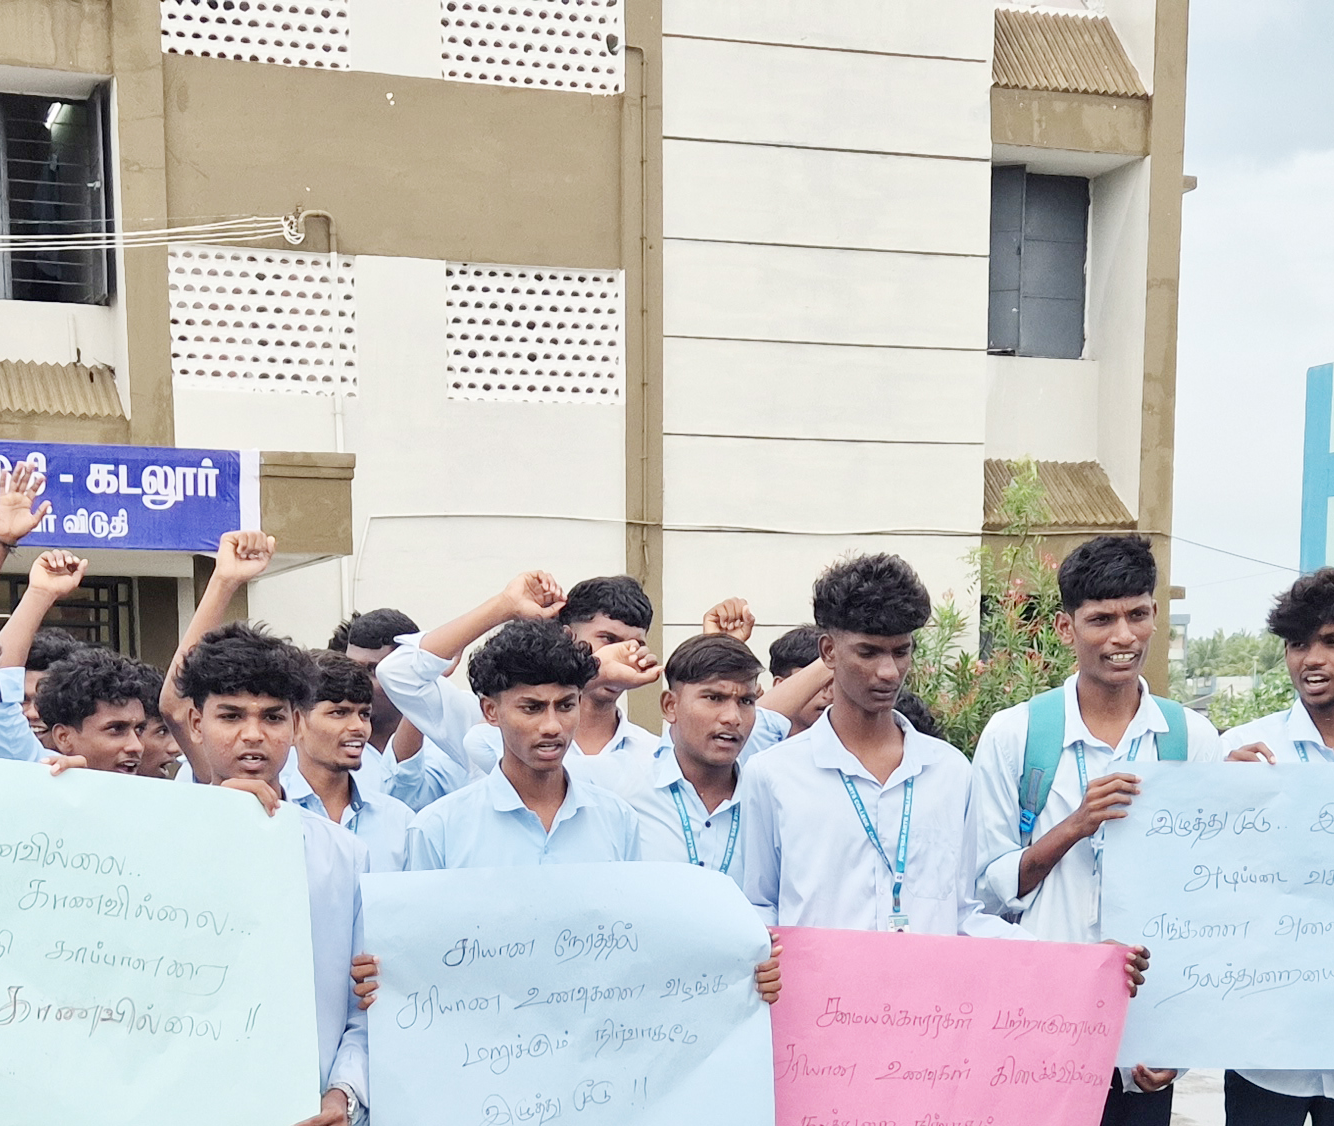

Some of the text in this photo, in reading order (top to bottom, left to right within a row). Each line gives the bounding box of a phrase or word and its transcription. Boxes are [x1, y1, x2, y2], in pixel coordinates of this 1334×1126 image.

[86, 458, 220, 510] கடலூர்
[63, 507, 129, 540] விடுதி
[846, 782, 857, 799] ARTS
[854, 799, 869, 828] COLLEGE
[1183, 864, 1288, 893] அடிப்படை
[442, 920, 639, 967] சரியான நேரத்தில்
[396, 984, 501, 1031] சரியான
[462, 1029, 569, 1075] மறுக்கும்
[875, 1058, 972, 1090] உணவுகள்
